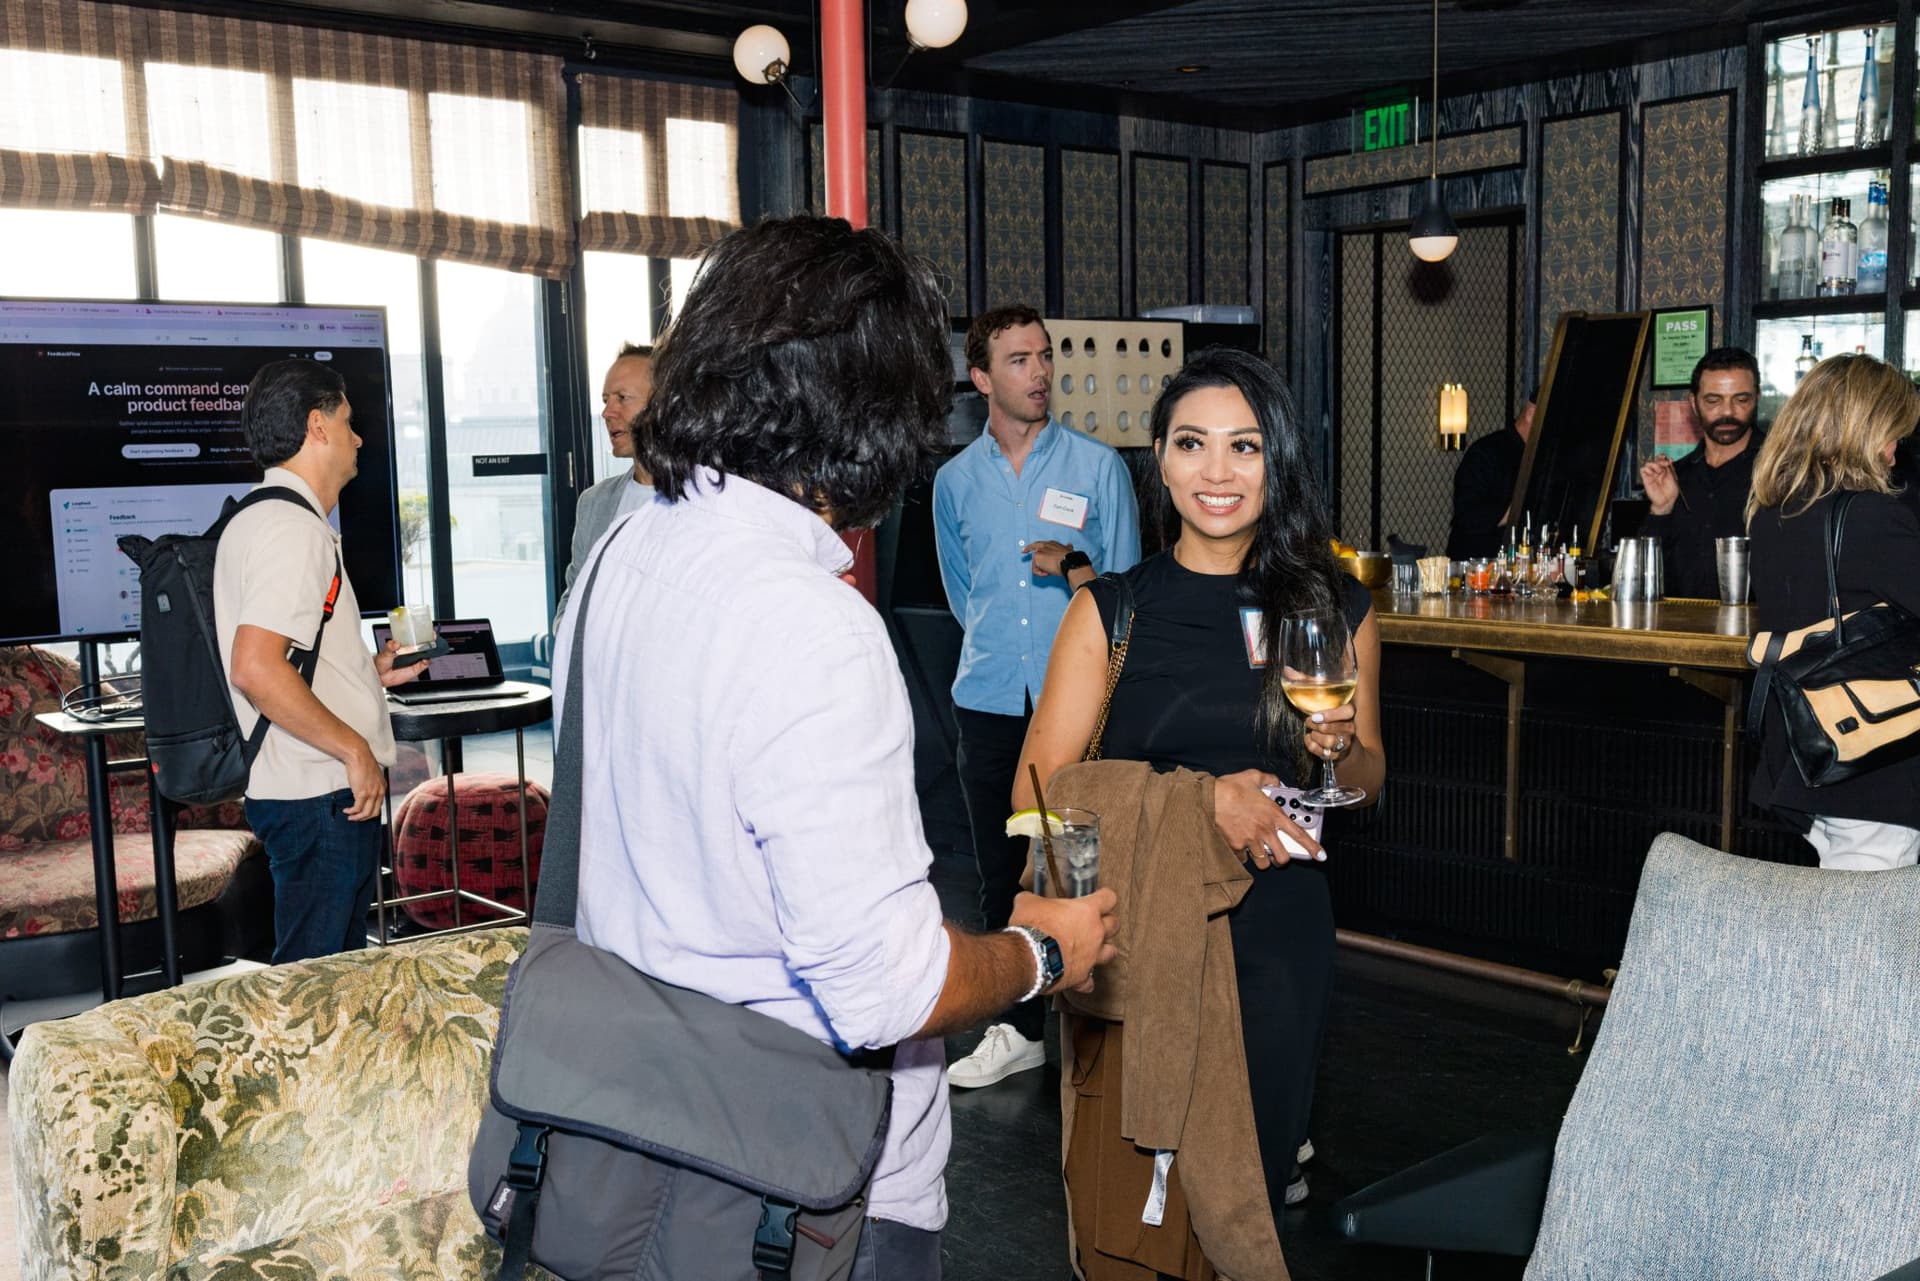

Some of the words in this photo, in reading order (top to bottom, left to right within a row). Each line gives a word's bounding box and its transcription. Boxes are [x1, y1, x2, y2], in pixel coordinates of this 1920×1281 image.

[1364, 103, 1408, 151] EXIT
[1666, 320, 1698, 332] PASS
[88, 382, 100, 396] A
[103, 382, 141, 396] calm
[144, 382, 219, 396] command
[128, 398, 187, 414] product
